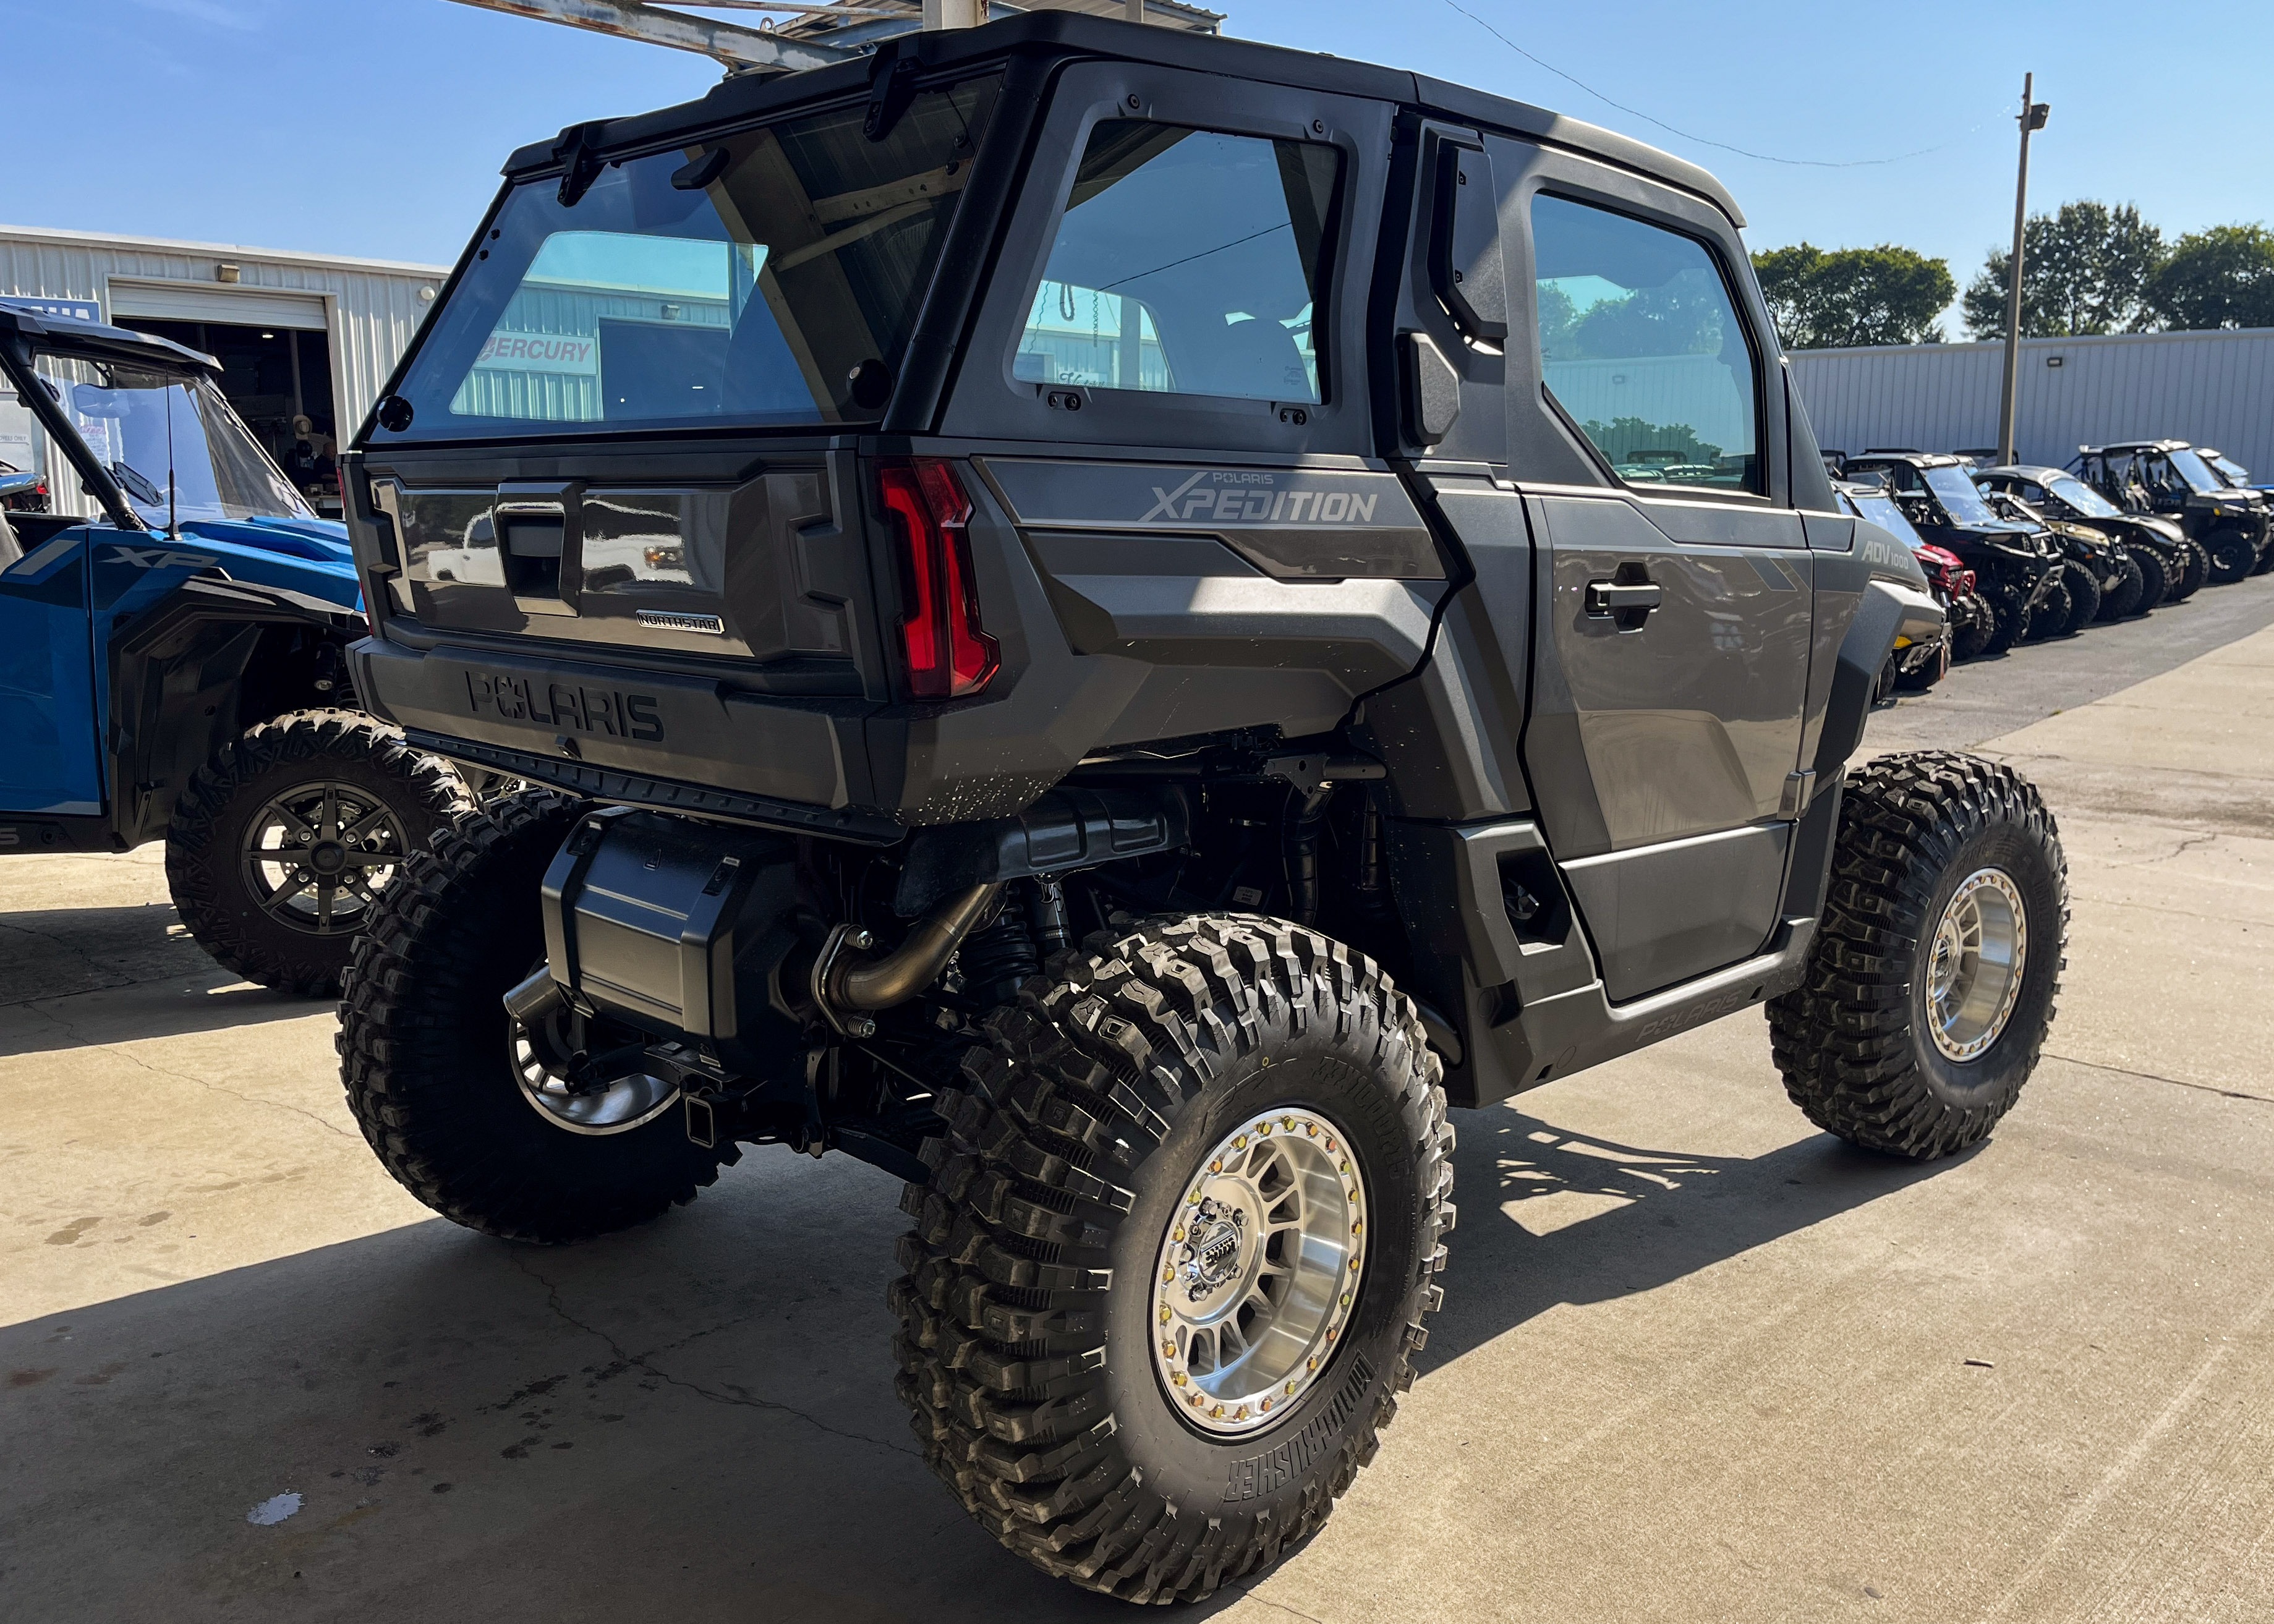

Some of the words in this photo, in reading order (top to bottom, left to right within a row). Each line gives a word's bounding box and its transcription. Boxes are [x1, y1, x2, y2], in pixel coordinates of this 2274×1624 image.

[1212, 472, 1274, 485] POLARIS
[1138, 472, 1378, 522] XPEDITION
[98, 546, 220, 569] XP
[1861, 540, 1890, 564] ADV
[1891, 552, 1909, 570] 1000
[639, 614, 717, 631] NORTHSTAR
[465, 670, 665, 742] POLARIS
[1635, 990, 1742, 1043] POLARIS
